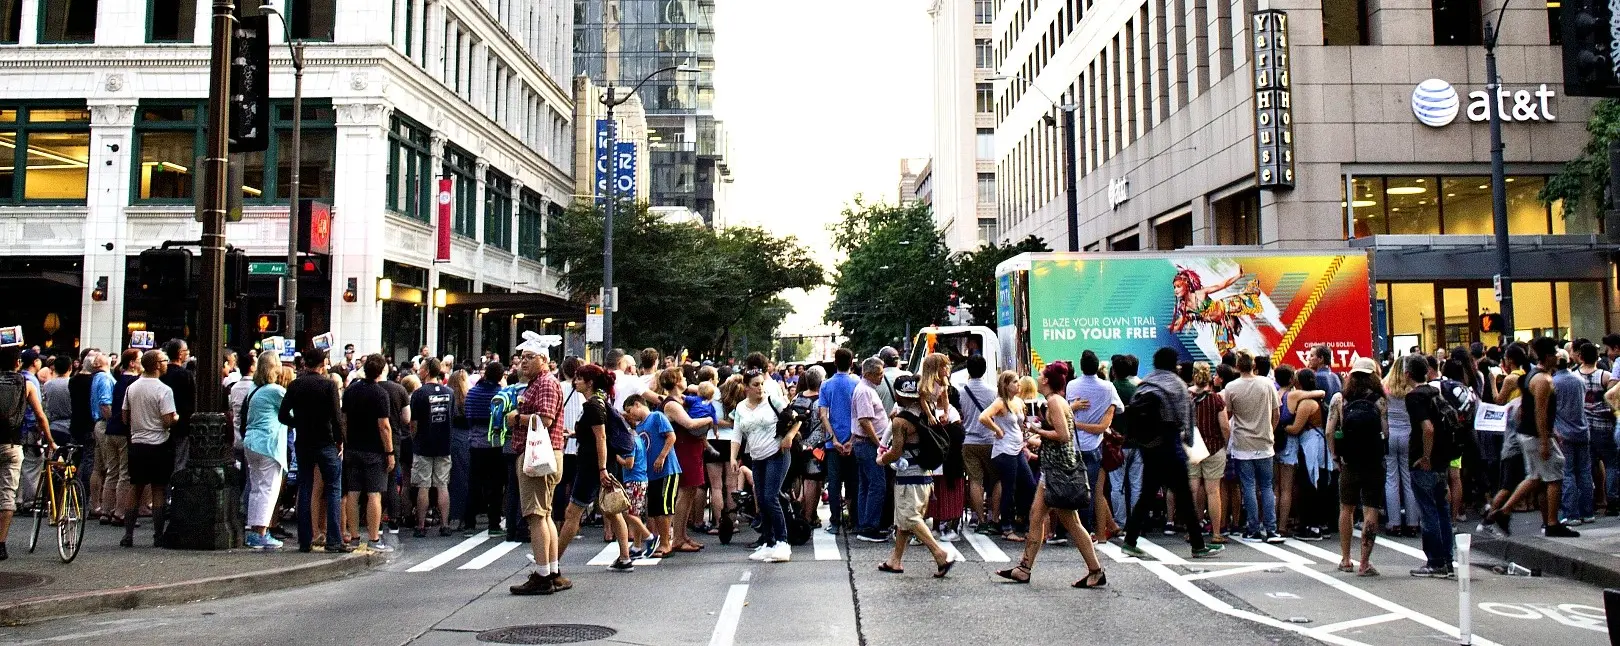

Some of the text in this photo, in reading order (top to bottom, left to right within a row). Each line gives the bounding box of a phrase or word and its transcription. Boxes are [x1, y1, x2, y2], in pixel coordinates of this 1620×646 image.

[1042, 316, 1156, 327] BLAZE YOUR OWN TRAIL
[1043, 327, 1157, 340] FIND YOUR FREE
[1296, 349, 1363, 368] VLTA
